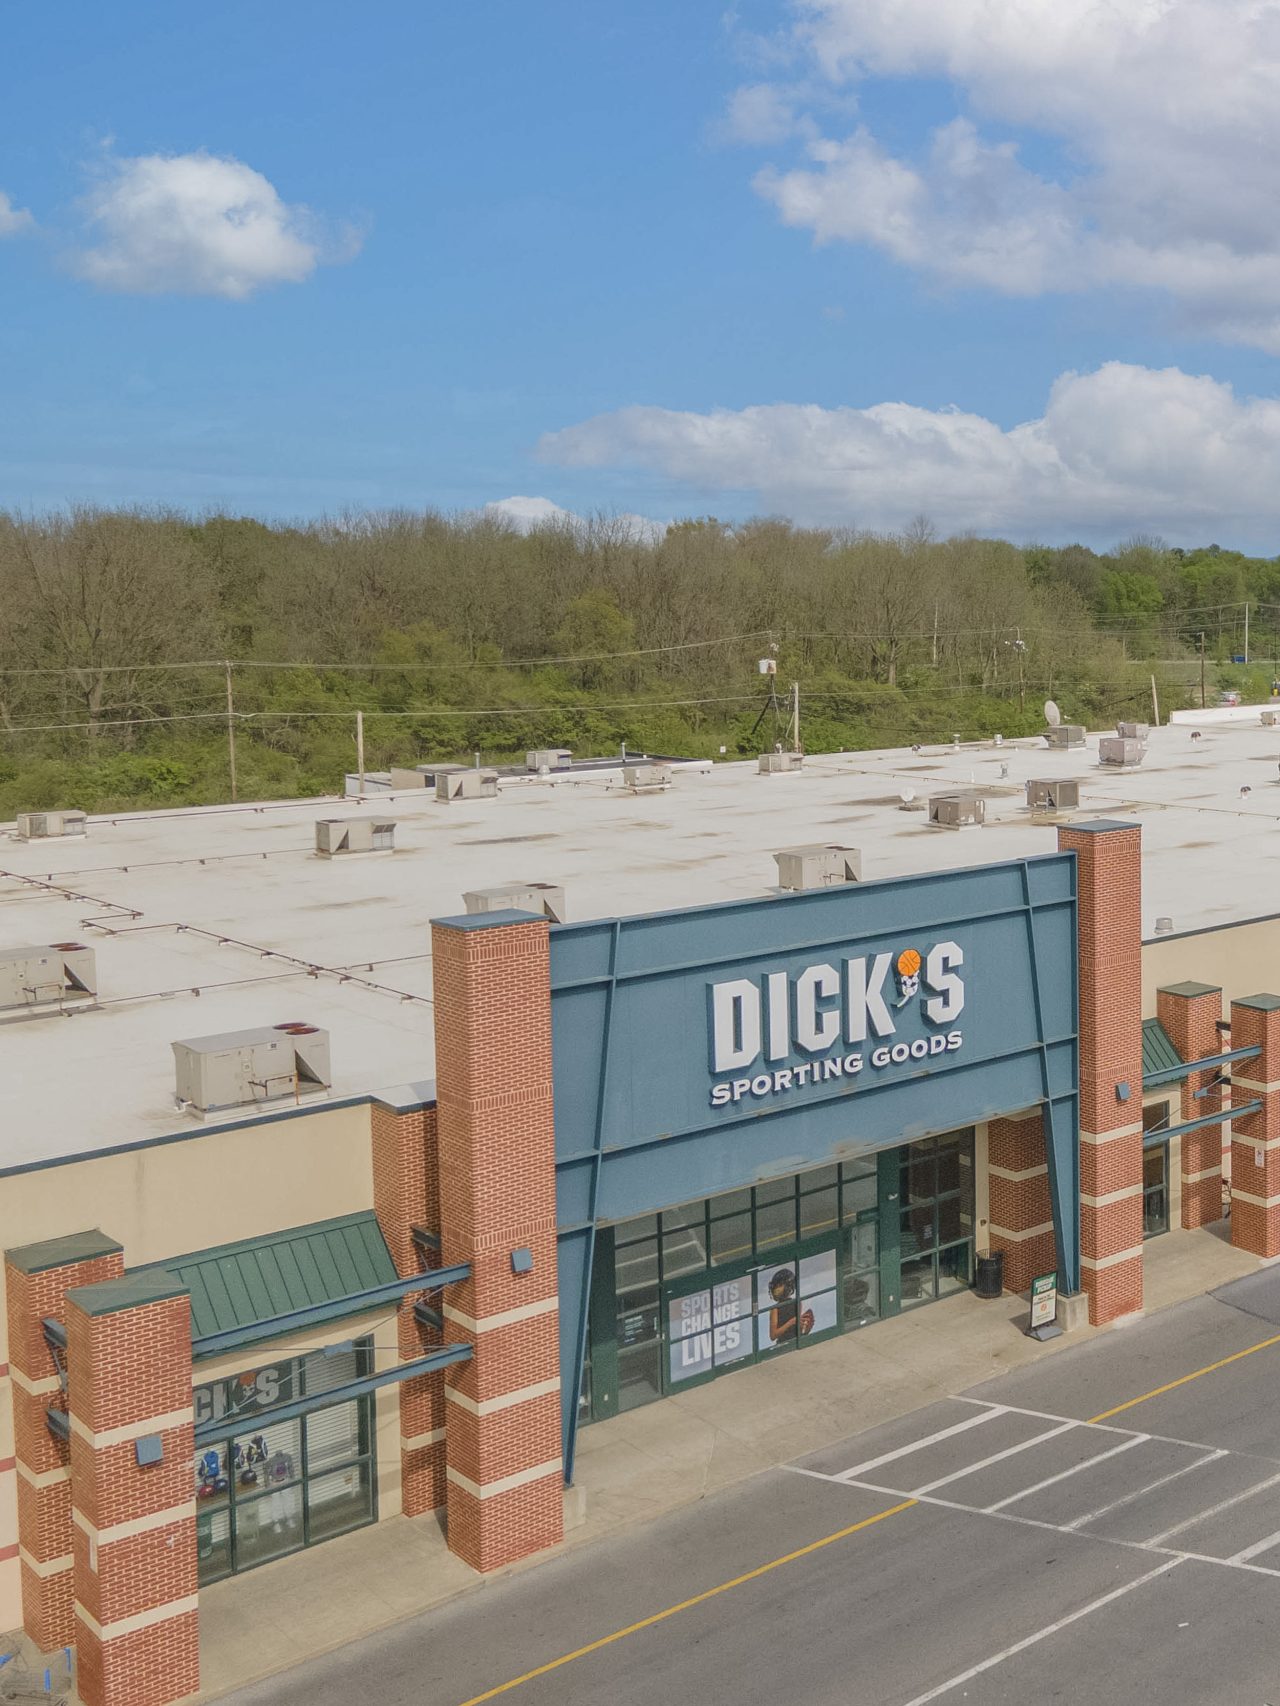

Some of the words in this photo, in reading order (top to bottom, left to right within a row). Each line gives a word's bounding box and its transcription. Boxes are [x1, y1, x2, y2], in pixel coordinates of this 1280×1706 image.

[708, 941, 965, 1073] DICK'S
[711, 1053, 864, 1106] SPORTING
[872, 1031, 963, 1068] GOODS
[680, 1283, 740, 1318] SPORTS
[681, 1301, 740, 1346] CHANGE
